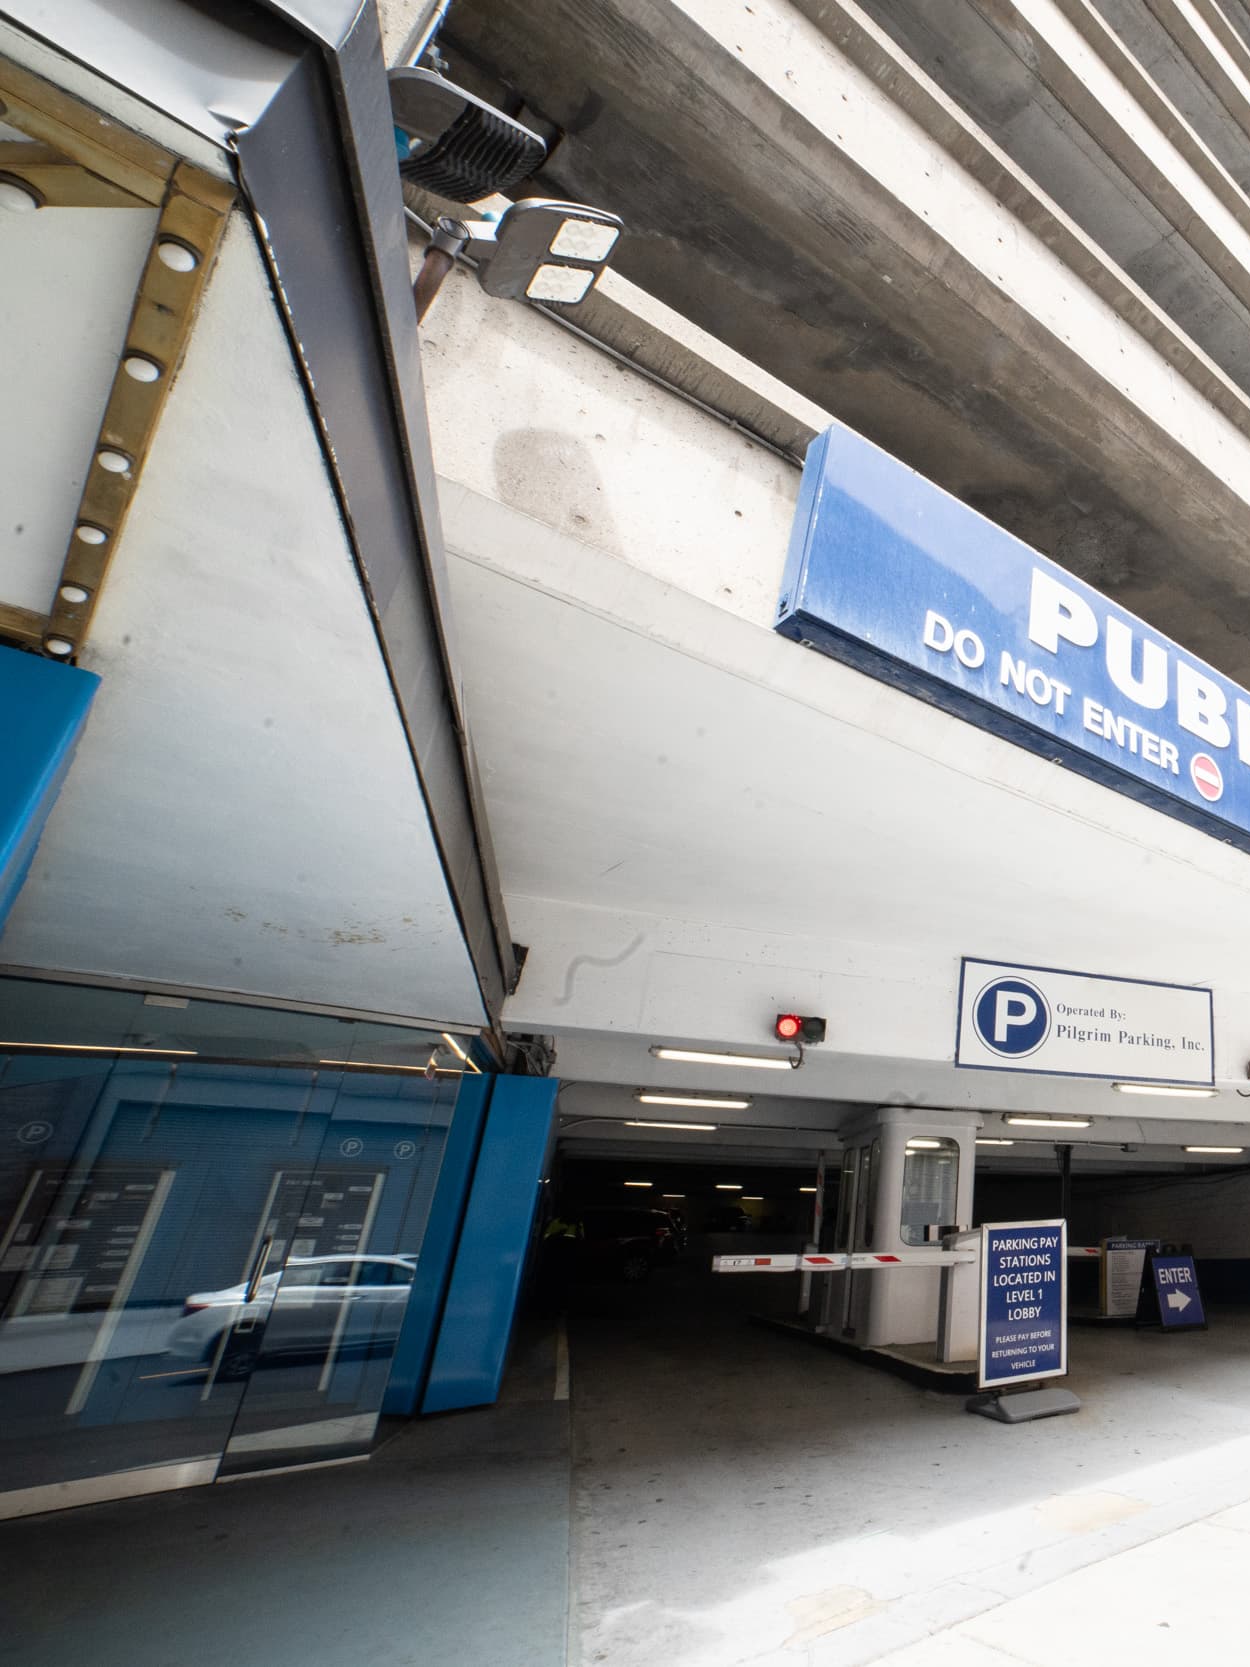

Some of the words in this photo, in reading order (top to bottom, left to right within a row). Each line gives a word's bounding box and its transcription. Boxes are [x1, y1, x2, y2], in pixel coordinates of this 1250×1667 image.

[924, 609, 985, 669] DO
[1001, 651, 1071, 715] NOT
[1082, 696, 1180, 775] ENTER
[1056, 1002, 1105, 1018] Operated
[1109, 1008, 1127, 1021] By:
[1056, 1023, 1112, 1043] Pilgrim
[1118, 1030, 1176, 1051] Parking,
[1181, 1035, 1206, 1052] Inc.
[992, 1237, 1038, 1251] PARKING
[1039, 1236, 1059, 1248] PAY
[1000, 1254, 1051, 1269] STATIONS
[994, 1272, 1042, 1287] LOCATED
[1044, 1270, 1056, 1281] IN
[1158, 1267, 1193, 1285] ENTER
[1006, 1289, 1035, 1303] LEVEL
[1038, 1289, 1043, 1300] 1
[1008, 1306, 1042, 1321] LOBBY
[996, 1334, 1017, 1344] PLEASE
[1017, 1333, 1030, 1341] PAY
[1030, 1330, 1052, 1340] BEFORE
[992, 1347, 1028, 1359] RETURNING
[1028, 1345, 1038, 1354] TO
[1038, 1343, 1055, 1352] YOUR
[1011, 1359, 1036, 1370] VEHICLE
